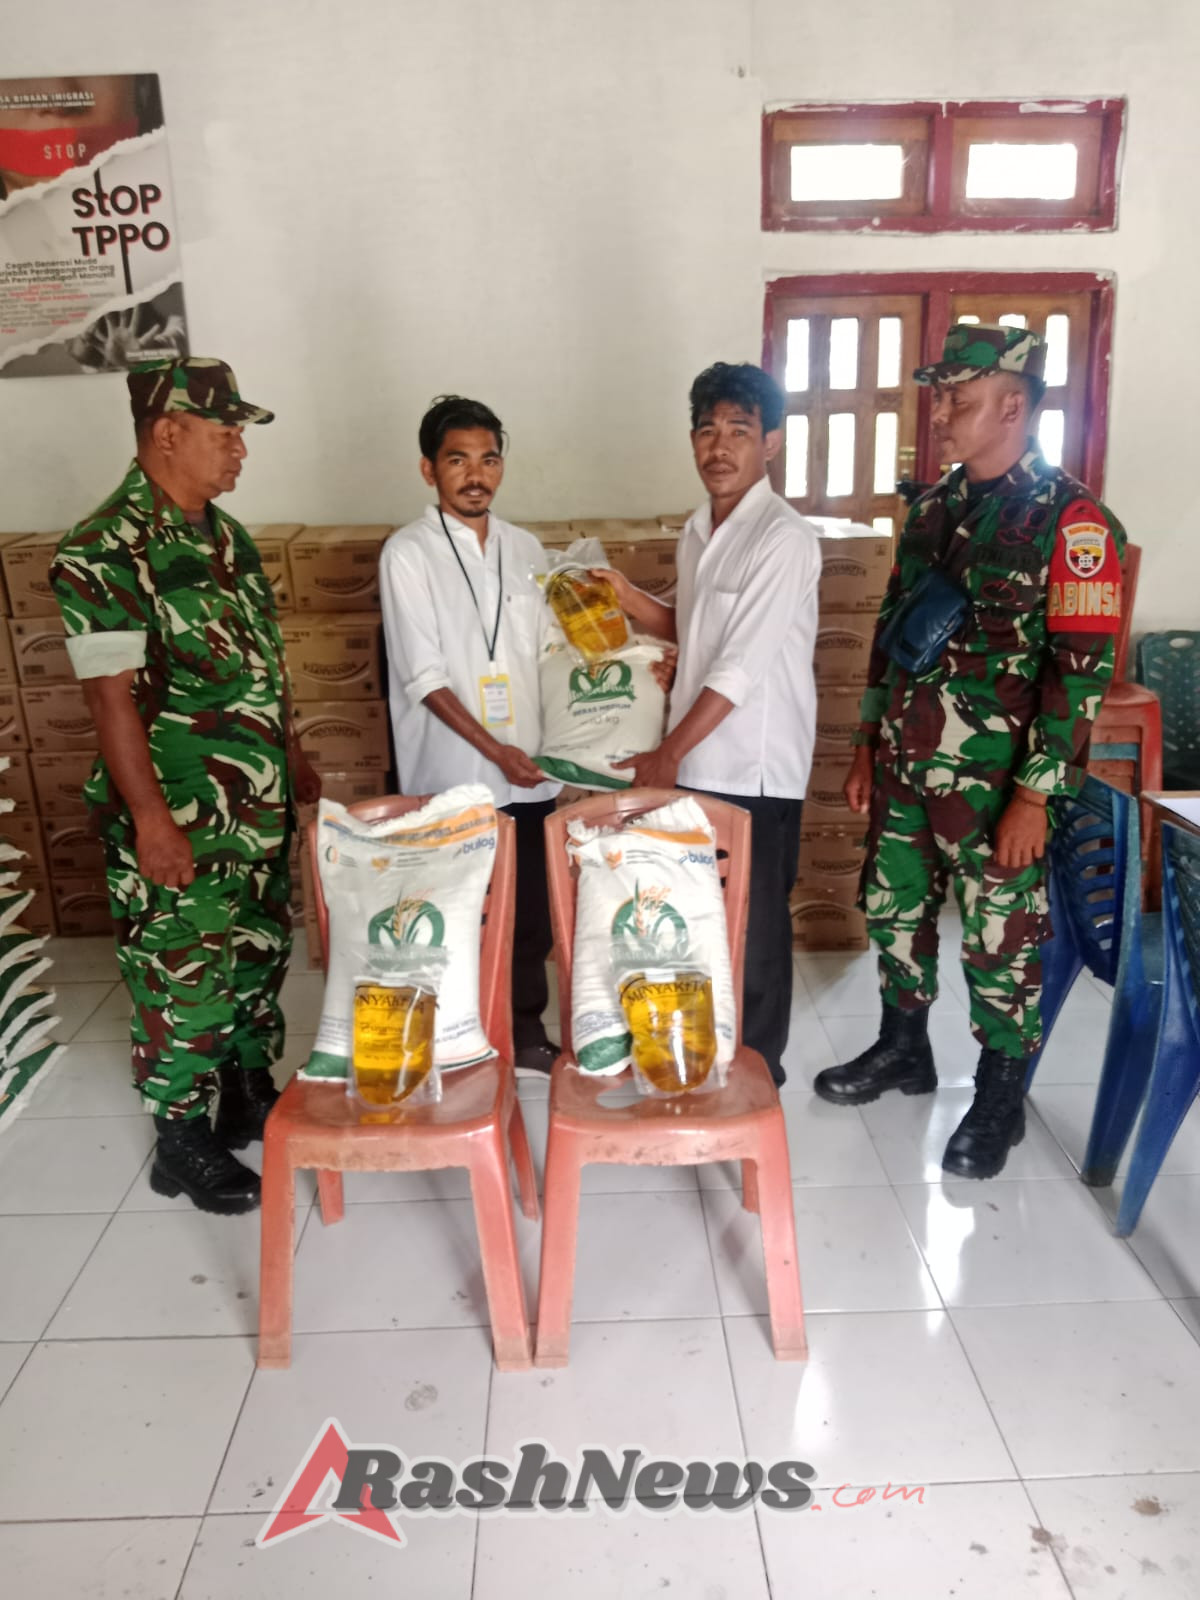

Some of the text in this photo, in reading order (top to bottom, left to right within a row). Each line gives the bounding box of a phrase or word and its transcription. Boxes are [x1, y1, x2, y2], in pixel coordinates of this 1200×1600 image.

[51, 91, 94, 100] IMIGRASI
[44, 144, 87, 160] STOP
[463, 837, 495, 854] bulog
